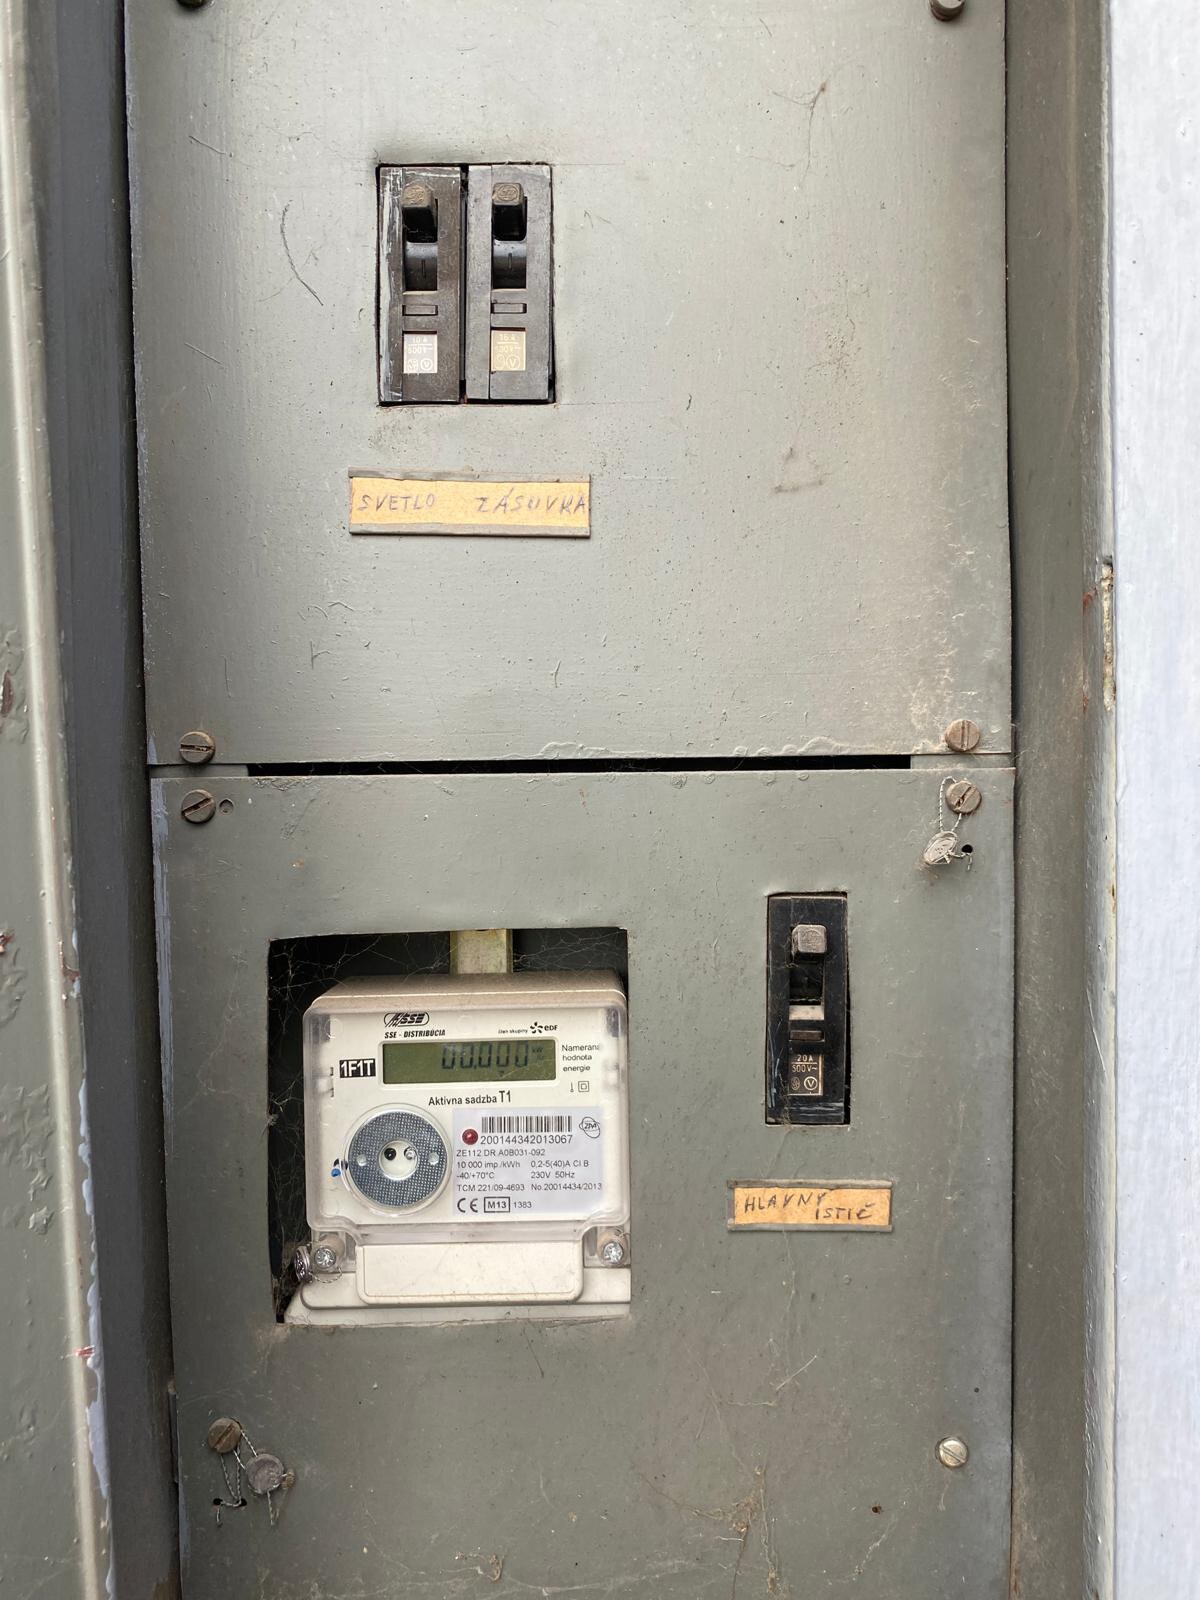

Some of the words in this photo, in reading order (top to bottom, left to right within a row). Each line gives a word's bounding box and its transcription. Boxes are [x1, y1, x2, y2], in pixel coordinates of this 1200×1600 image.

[358, 493, 436, 511] SVETLO
[475, 488, 586, 514] ZÁSUVKA
[384, 1031, 398, 1039] SSE
[340, 1060, 374, 1076] 1F1T
[465, 1094, 497, 1104] sadzba
[499, 1090, 511, 1102] T1
[480, 1134, 573, 1144] 200144342013067
[487, 1201, 507, 1209] M13
[514, 1201, 532, 1209] 1383
